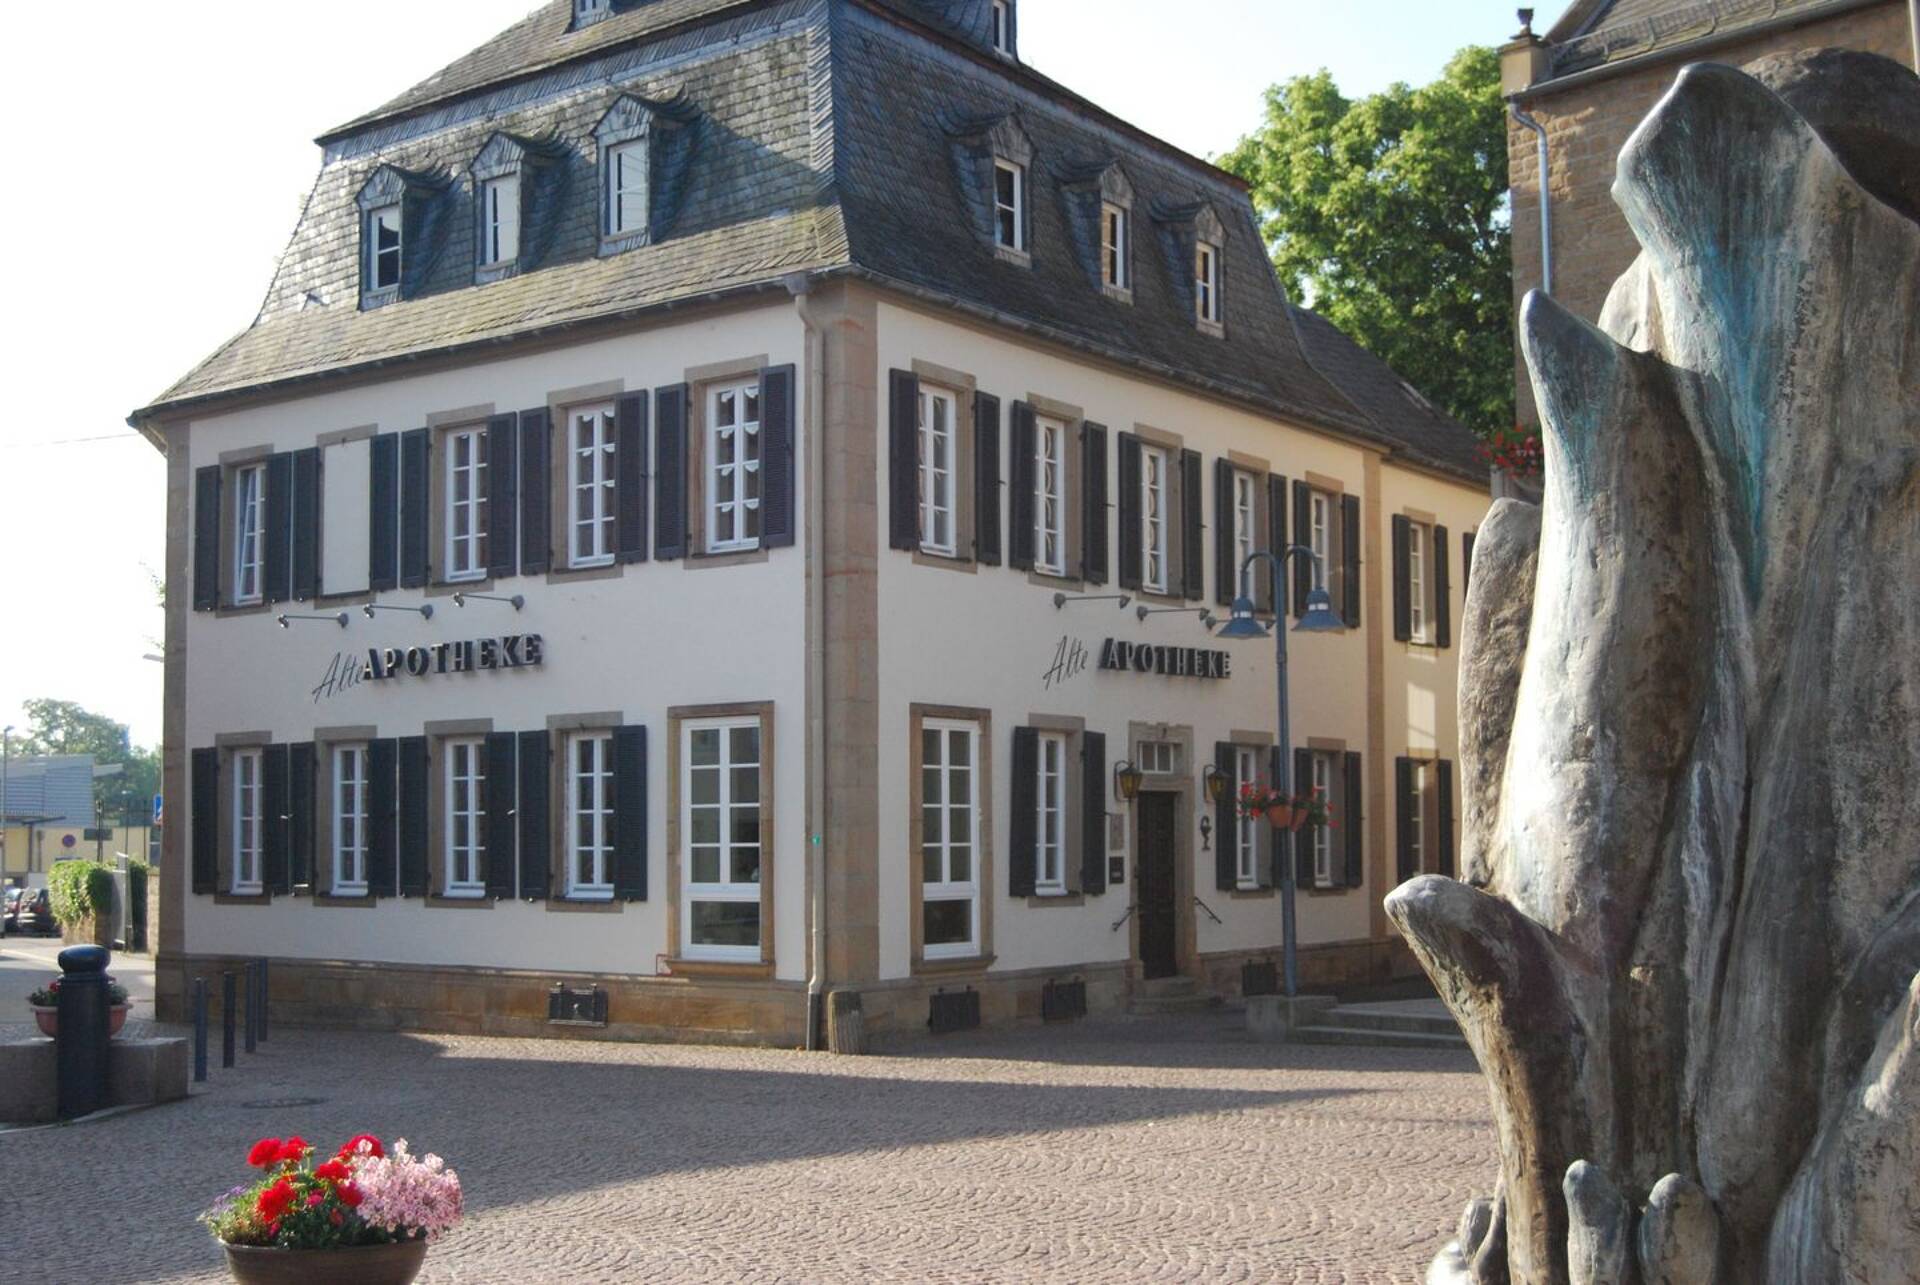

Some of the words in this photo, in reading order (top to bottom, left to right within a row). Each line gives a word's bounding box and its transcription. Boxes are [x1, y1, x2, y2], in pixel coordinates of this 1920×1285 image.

[312, 651, 364, 704] Alte
[362, 632, 544, 680] APOTHEKE
[1042, 635, 1089, 690] Alte
[1098, 637, 1232, 679] APOTHEKE
